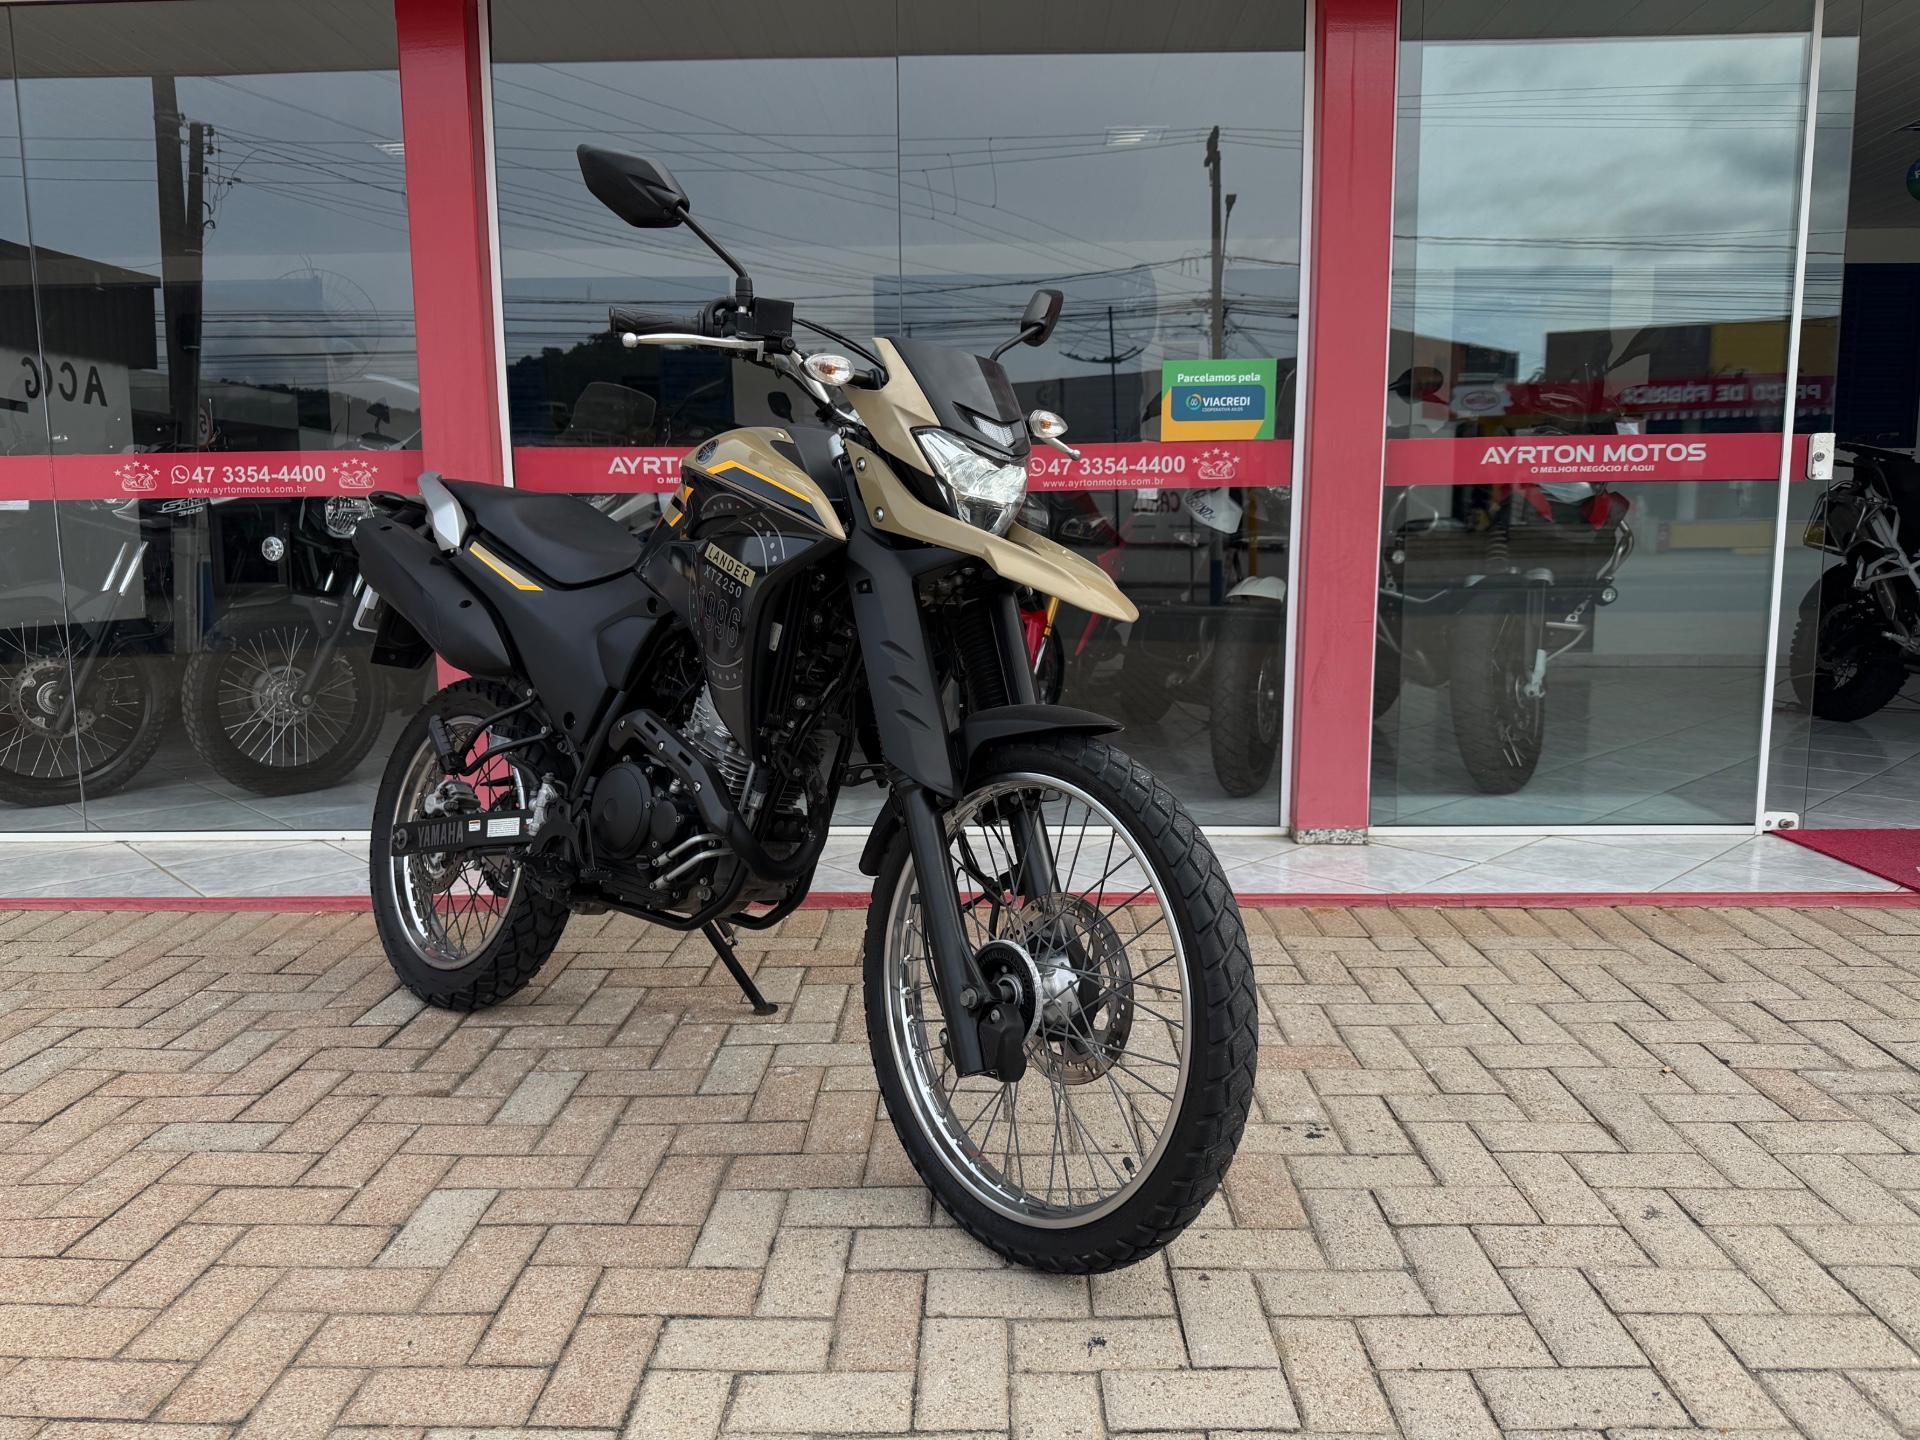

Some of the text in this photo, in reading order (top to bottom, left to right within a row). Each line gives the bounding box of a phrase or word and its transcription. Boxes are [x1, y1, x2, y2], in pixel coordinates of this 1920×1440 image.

[1177, 372, 1261, 384] Parcelamos pela
[1202, 396, 1250, 407] VIACREDI
[1481, 443, 1707, 464] AYRTON MOTOS
[191, 464, 326, 484] 47 3354-4400
[608, 456, 682, 474] AYRT
[1048, 455, 1185, 475] 47 3354-4400
[1579, 464, 1621, 473] NEGÓCIO
[1623, 463, 1630, 472] É
[1630, 464, 1655, 472] AQUI
[188, 486, 307, 496] www.ayrtonmotos.com.br
[1043, 477, 1164, 488] www.ayrtonmotos.com.br
[178, 506, 204, 517] 300
[707, 546, 750, 582] LANDER
[703, 564, 742, 598] XTZ250
[697, 583, 742, 648] 1996
[417, 820, 464, 848] YAMAHA
